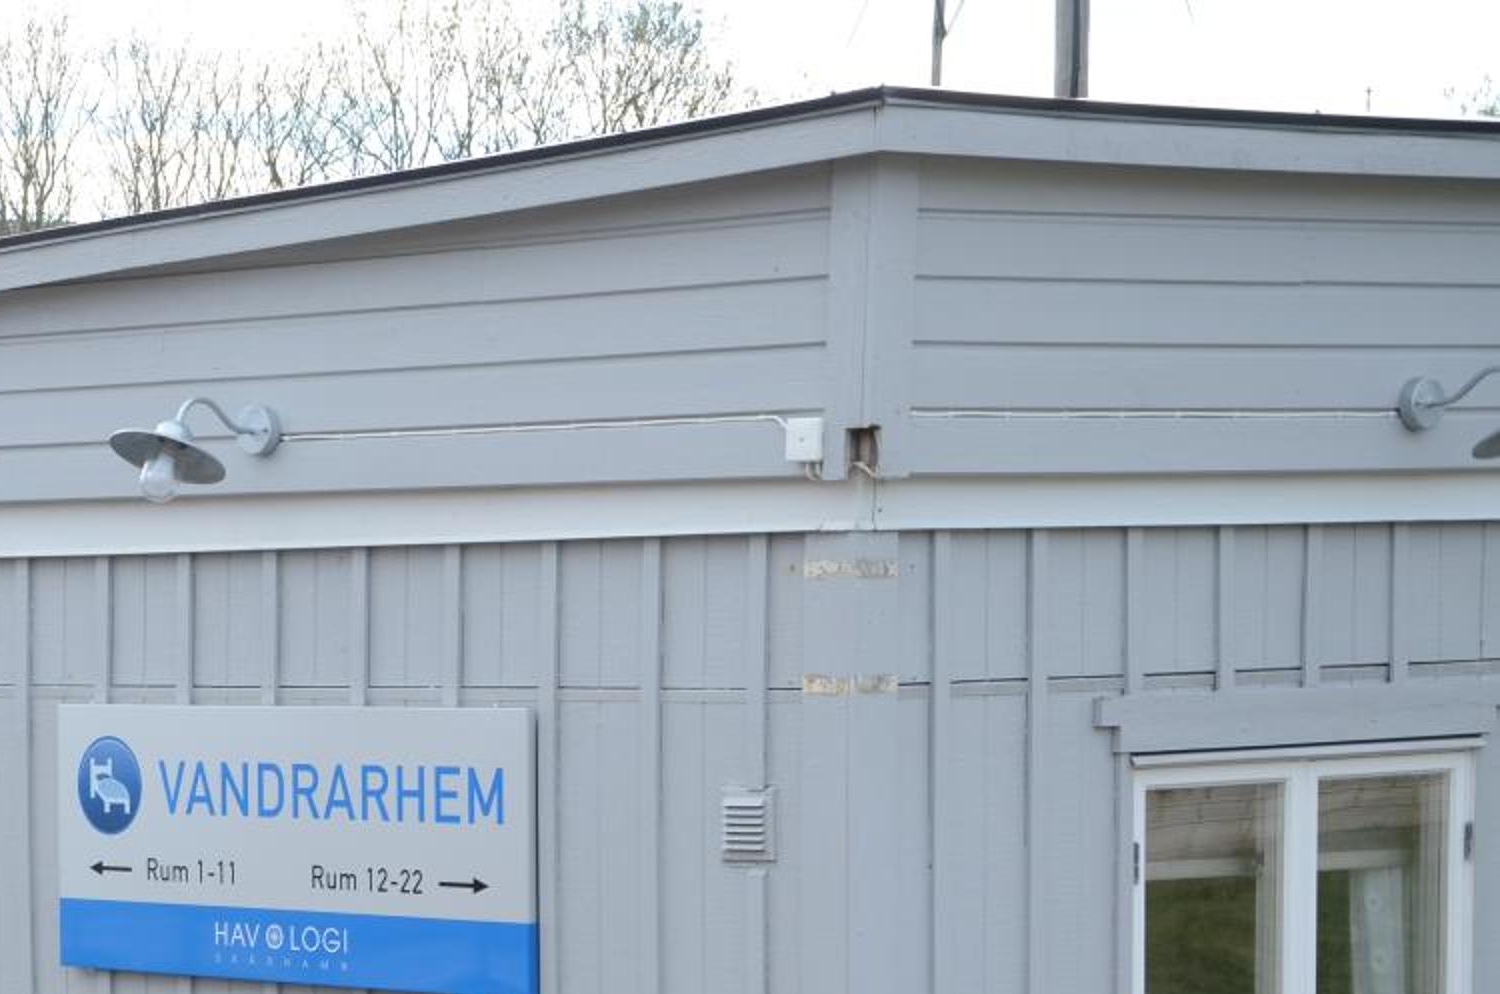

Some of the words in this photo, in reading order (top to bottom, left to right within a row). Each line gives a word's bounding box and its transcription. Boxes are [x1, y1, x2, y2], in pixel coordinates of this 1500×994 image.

[157, 759, 506, 826] VANDRARHEM
[147, 857, 189, 883] Rum
[197, 860, 235, 885] 1-11
[311, 865, 357, 891] Rum
[367, 867, 423, 895] 12-22
